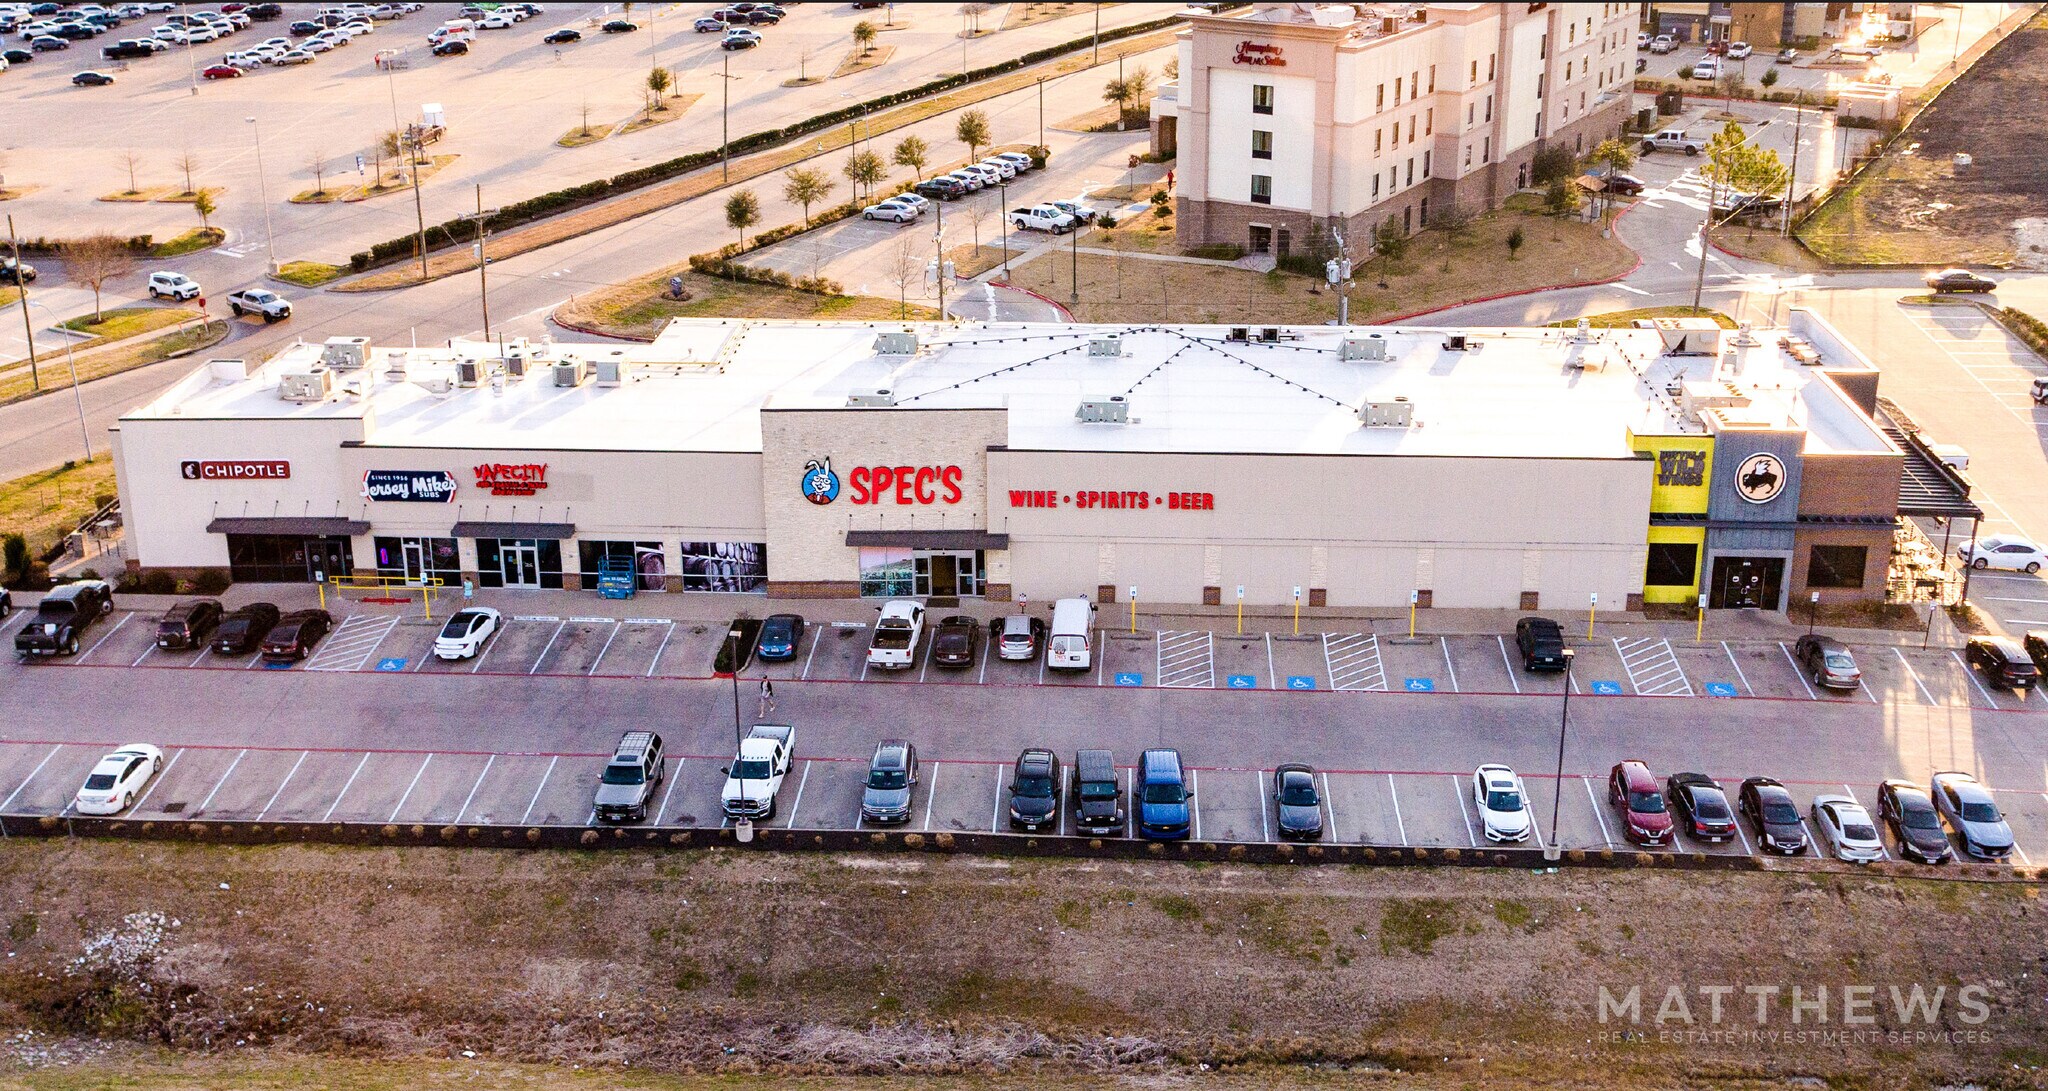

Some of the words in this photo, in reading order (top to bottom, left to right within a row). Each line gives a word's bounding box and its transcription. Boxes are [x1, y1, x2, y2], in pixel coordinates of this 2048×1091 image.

[205, 465, 286, 477] CHIPOTLE
[360, 481, 409, 498] Jersey
[412, 476, 457, 494] Mike's
[850, 466, 962, 505] SPEC'S
[1009, 490, 1057, 508] WINE
[1076, 491, 1149, 509] SPIRITS
[1168, 492, 1214, 510] BEER
